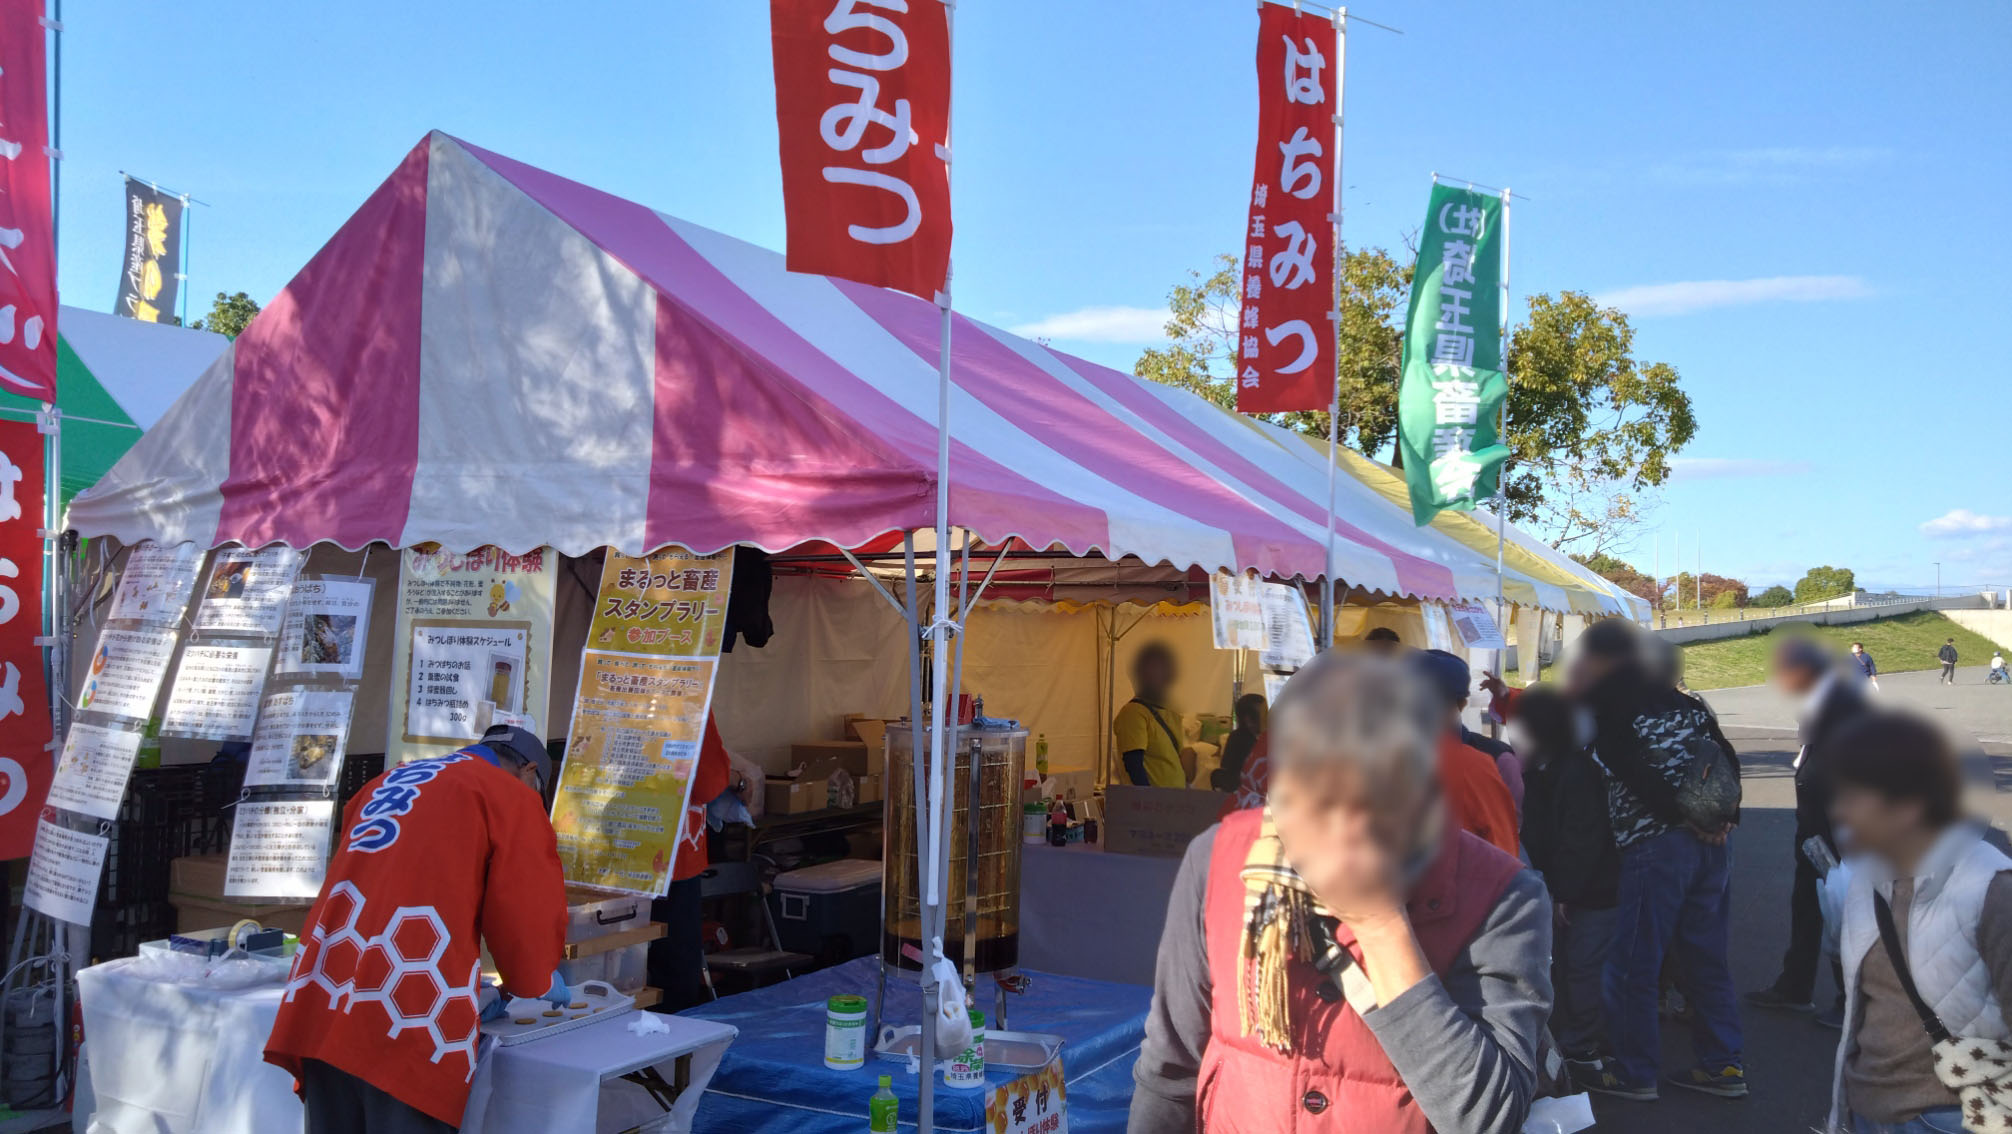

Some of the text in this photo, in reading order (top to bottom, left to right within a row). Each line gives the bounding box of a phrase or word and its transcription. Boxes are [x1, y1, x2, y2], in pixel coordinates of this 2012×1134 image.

[1265, 34, 1326, 375] はちみつ
[1241, 183, 1269, 389] 埼玉県養蜂協会
[617, 567, 720, 592] まるっと畜産
[603, 598, 720, 623] スタンプラリー
[427, 634, 512, 648] みつしぼり体験スケジュール
[626, 626, 694, 645] 参加ブース
[420, 659, 424, 669] 1
[418, 672, 424, 681] 2
[417, 684, 423, 694] 3
[416, 697, 422, 706] 4
[1013, 1084, 1049, 1127] 受付
